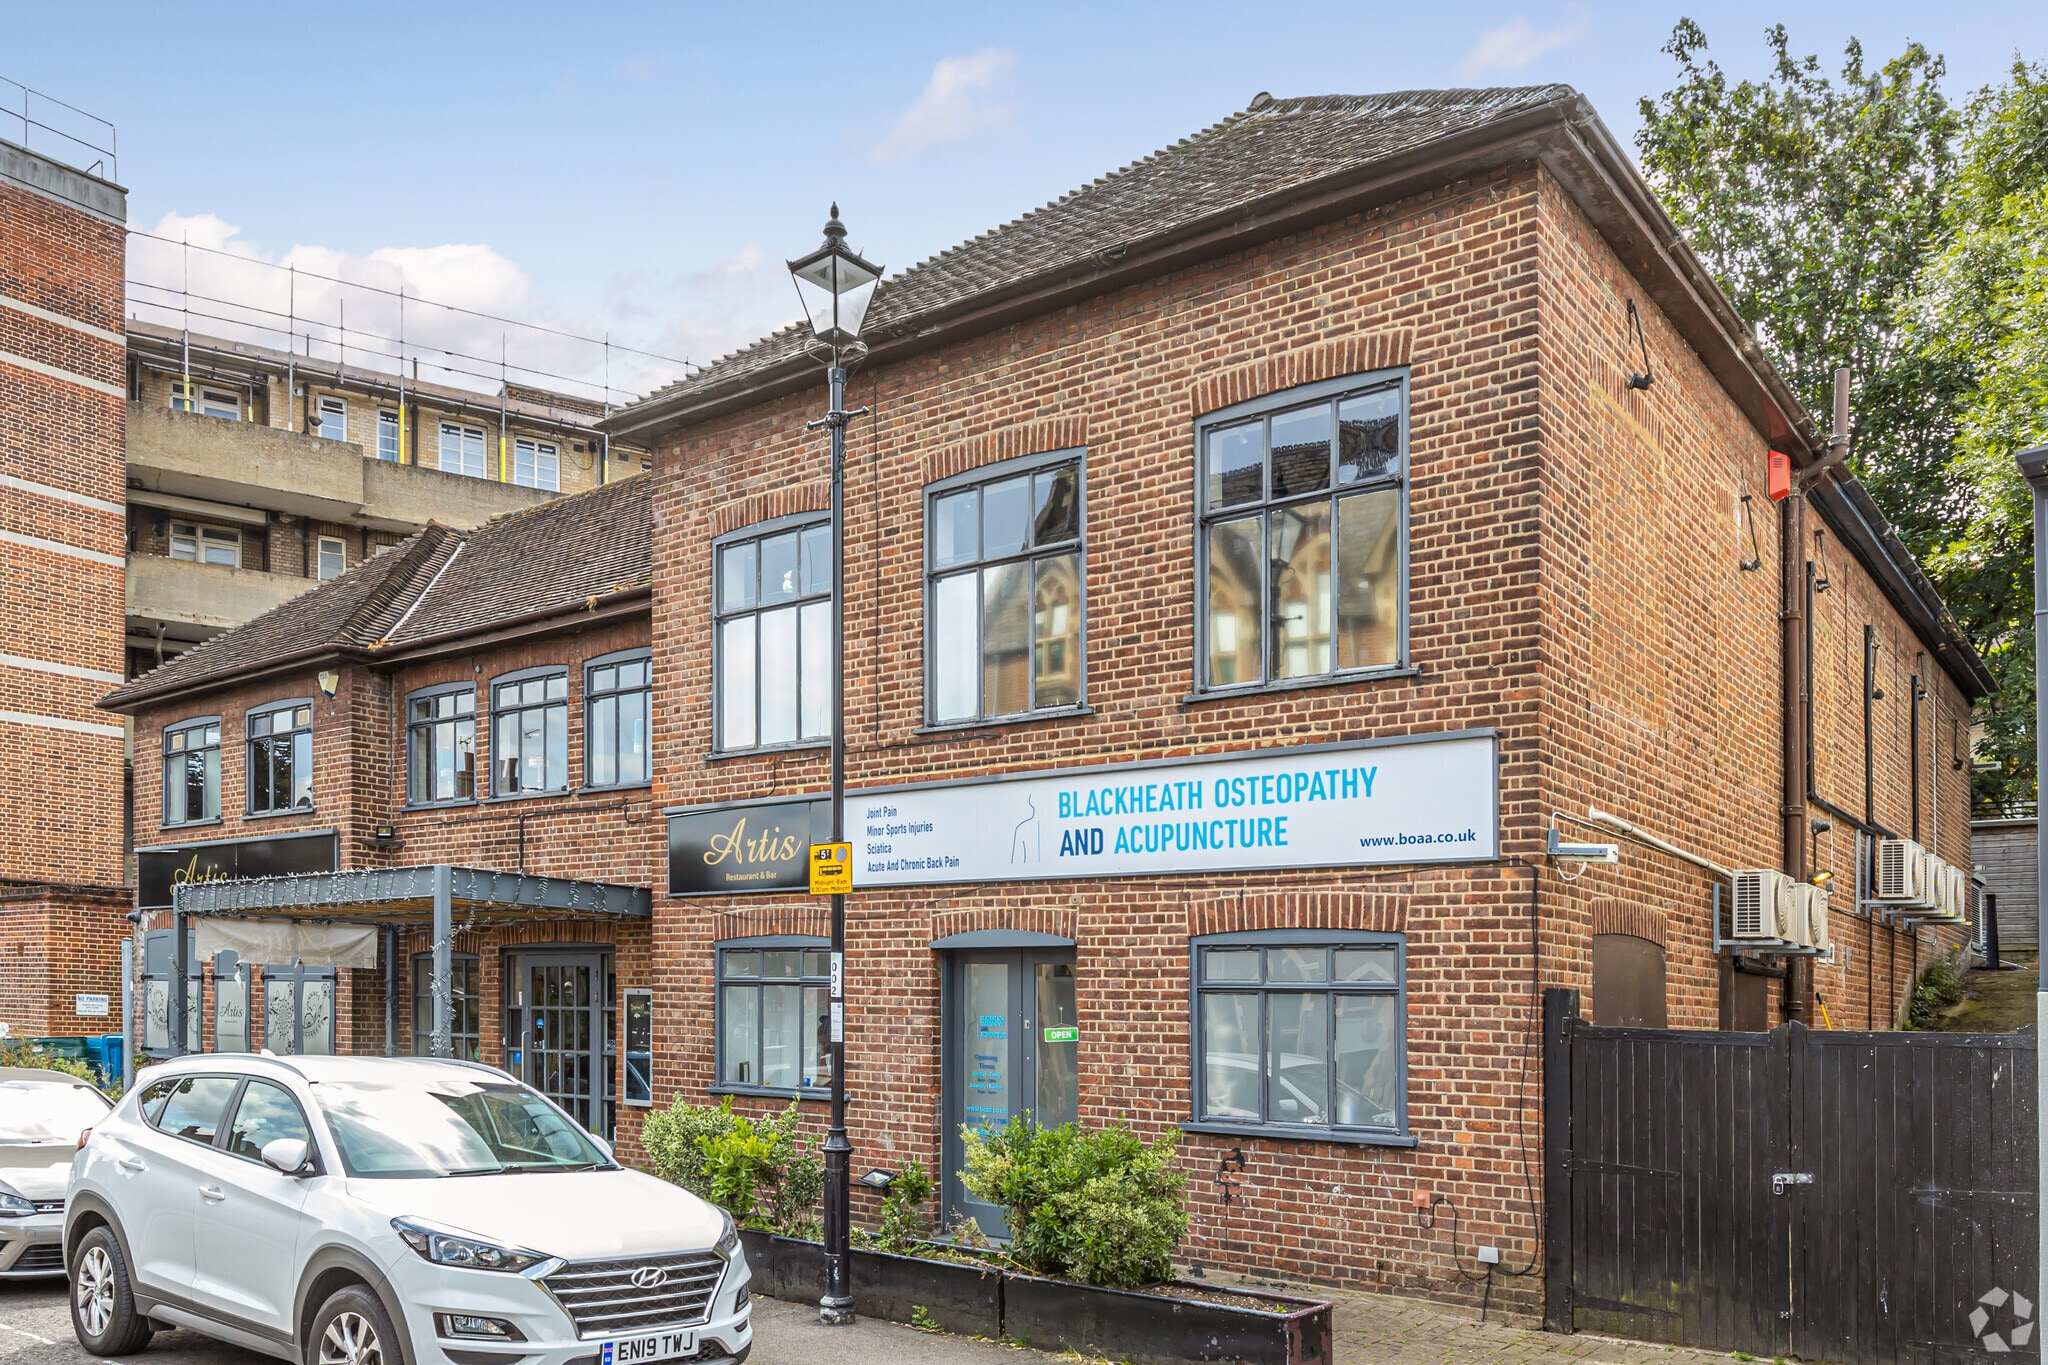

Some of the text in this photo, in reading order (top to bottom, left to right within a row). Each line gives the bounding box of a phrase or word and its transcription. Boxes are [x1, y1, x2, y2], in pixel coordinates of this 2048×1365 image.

[1058, 766, 1378, 819] BLACKHEATH OSTEOPATHY
[866, 806, 897, 819] Joint Pain
[866, 820, 933, 838] Minor Sports Injuries
[1059, 816, 1288, 857] AND ACUPUNCTURE
[1360, 828, 1476, 847] www.boaa.co.uk
[703, 817, 802, 865] Artis
[867, 842, 892, 855] Sciatica
[867, 855, 960, 873] Acute And Chronic Back Pain
[725, 870, 777, 881] Restaurant & Bar
[219, 1001, 243, 1017] Artis
[1051, 1030, 1072, 1039] OPEN
[618, 1332, 694, 1361] EN19 TWJ
